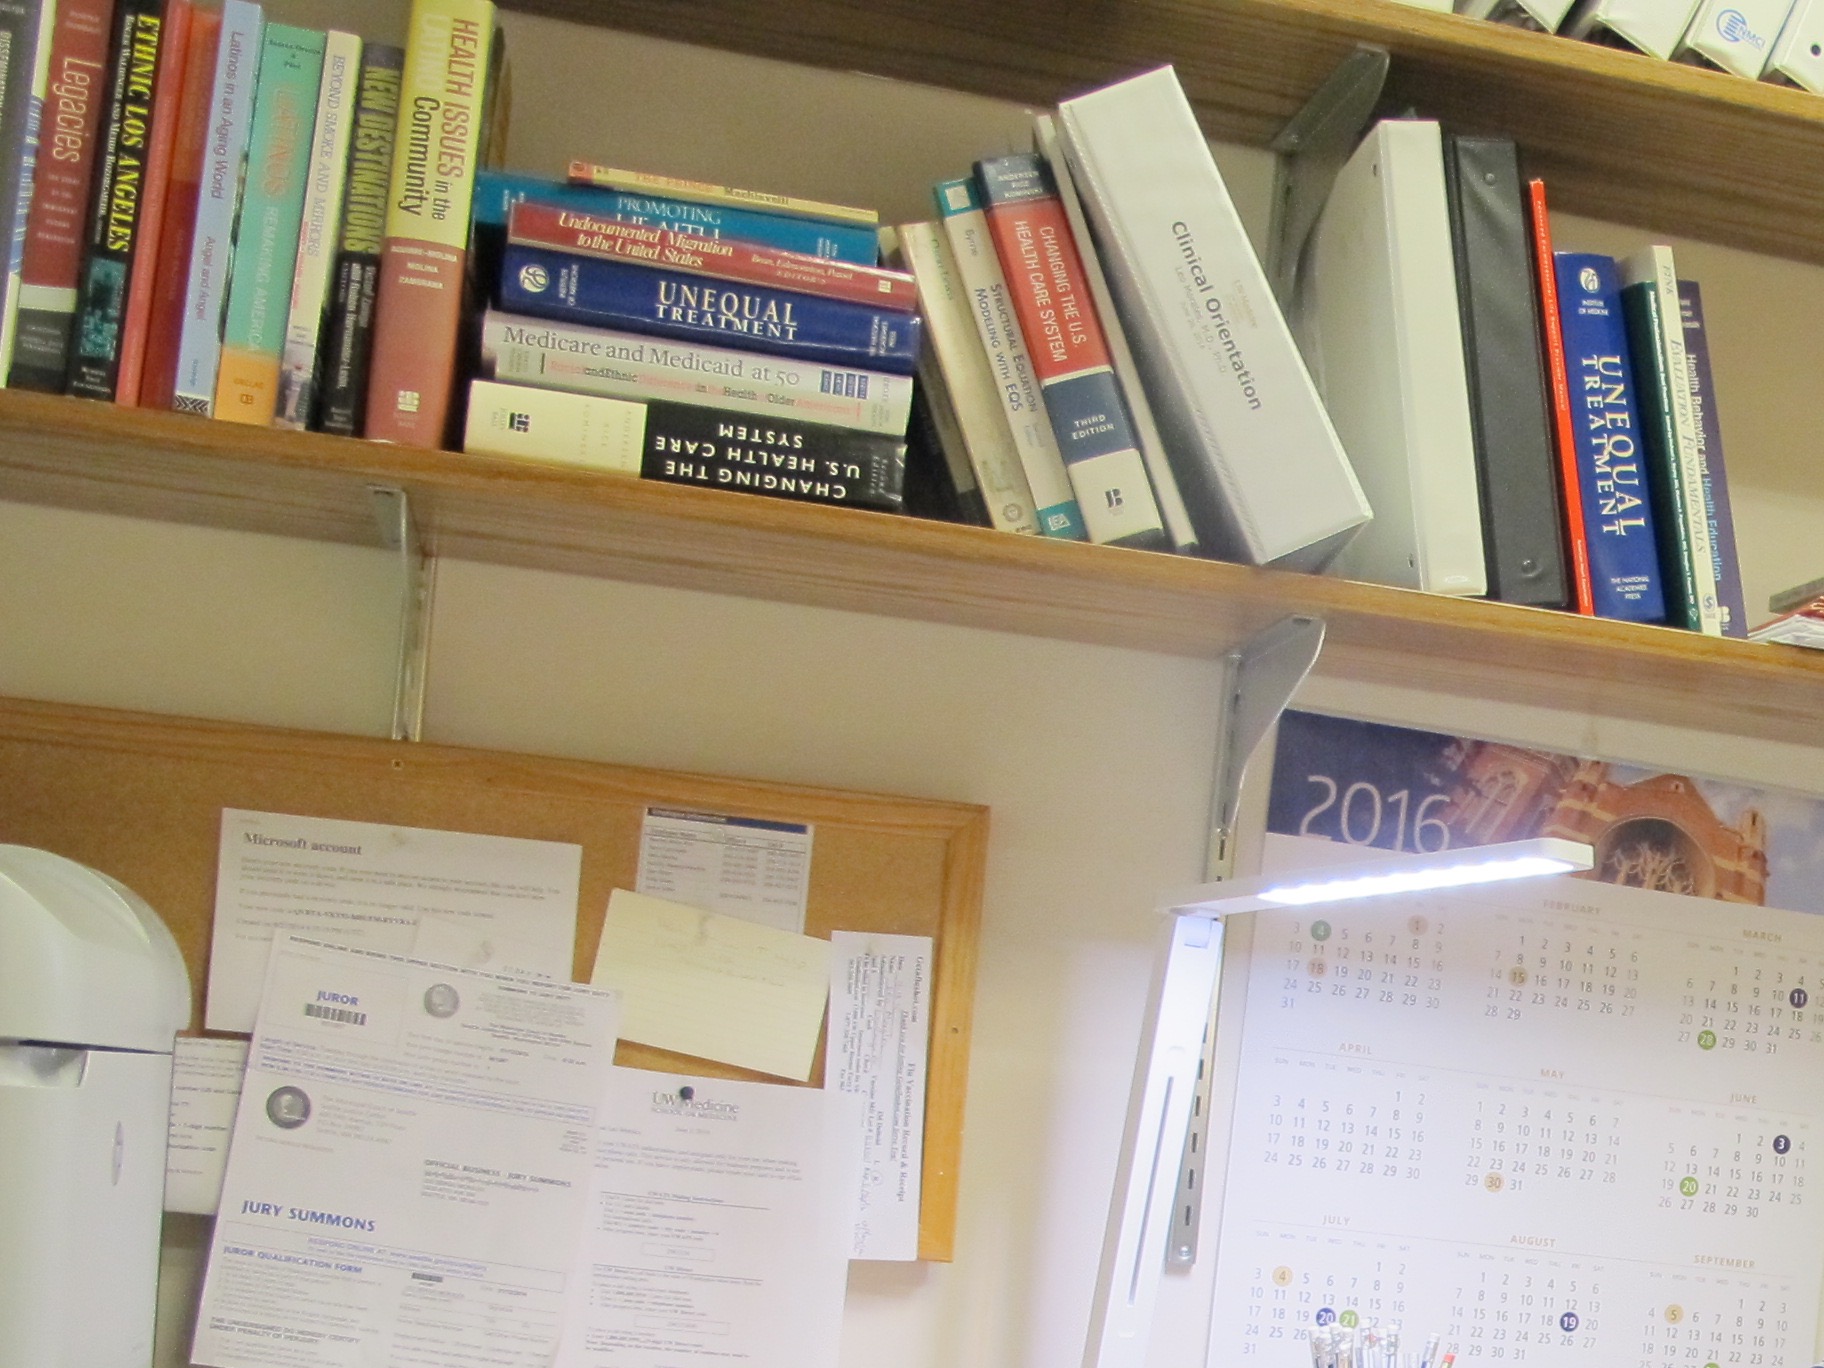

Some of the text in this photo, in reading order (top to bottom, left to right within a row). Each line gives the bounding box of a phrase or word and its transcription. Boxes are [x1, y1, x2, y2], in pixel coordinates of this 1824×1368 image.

[53, 57, 102, 163] Legacies
[361, 66, 401, 113] NEW
[107, 14, 161, 252] ETHNIC LOS ANGELES
[210, 30, 245, 200] Latinos in an Aging World
[431, 17, 480, 221] HEALTH ISSUES in the
[307, 55, 346, 258] BEYOND SMOKE AND MIRRORS
[397, 96, 441, 216] Community
[343, 112, 397, 254] DESTINATIONS
[617, 196, 722, 226] PROMOTING
[558, 211, 661, 243] Undocumented
[666, 229, 734, 258] Migration
[615, 238, 662, 260] United
[663, 246, 705, 267] States
[195, 235, 216, 321] Angel and Angel
[248, 206, 279, 351] REMAKING AMERICA
[1015, 220, 1068, 363] HEALTH CARE SYSTEM
[1040, 226, 1088, 348] CHANGING THE U.S.
[1662, 264, 1675, 295] FINK
[655, 303, 799, 342] TREATMENT
[658, 281, 798, 327] UNEQUAL
[974, 288, 1001, 349] MODELING
[1171, 220, 1263, 411] Clinical Orientation
[503, 325, 801, 387] Medicare and Medicaid at 50
[1013, 354, 1038, 413] EQUATION
[718, 423, 804, 449] SYSTEM
[1070, 423, 1115, 441] EDITION
[1073, 413, 1107, 428] THIRD
[655, 436, 862, 480] U.S. HEALTH CARE
[1582, 354, 1620, 536] TREATMENT
[1598, 355, 1646, 536] UNEQUAL
[1670, 339, 1691, 427] EVALUATION
[1681, 435, 1708, 555] FUNDAMENTALS
[1686, 354, 1723, 581] Health Behavior and Health Education
[664, 460, 848, 499] CHANGING THE
[1299, 774, 1452, 855] 2016
[243, 831, 363, 857] Microsoft account
[1543, 901, 1601, 916] FEBRUARY
[1742, 928, 1783, 943] MARCH
[316, 989, 361, 1007] JUROR
[1338, 1042, 1373, 1056] APRIL
[1540, 1068, 1566, 1080] MAY
[1730, 1094, 1757, 1104] JUNE
[241, 1199, 377, 1233] JURY SUMMONS
[1321, 1214, 1352, 1227] JULY
[223, 1246, 364, 1275] JUROR QUALIFICATION FORM
[1510, 1234, 1557, 1249] AUGUST
[1693, 1254, 1756, 1270] SEPTEMBER
